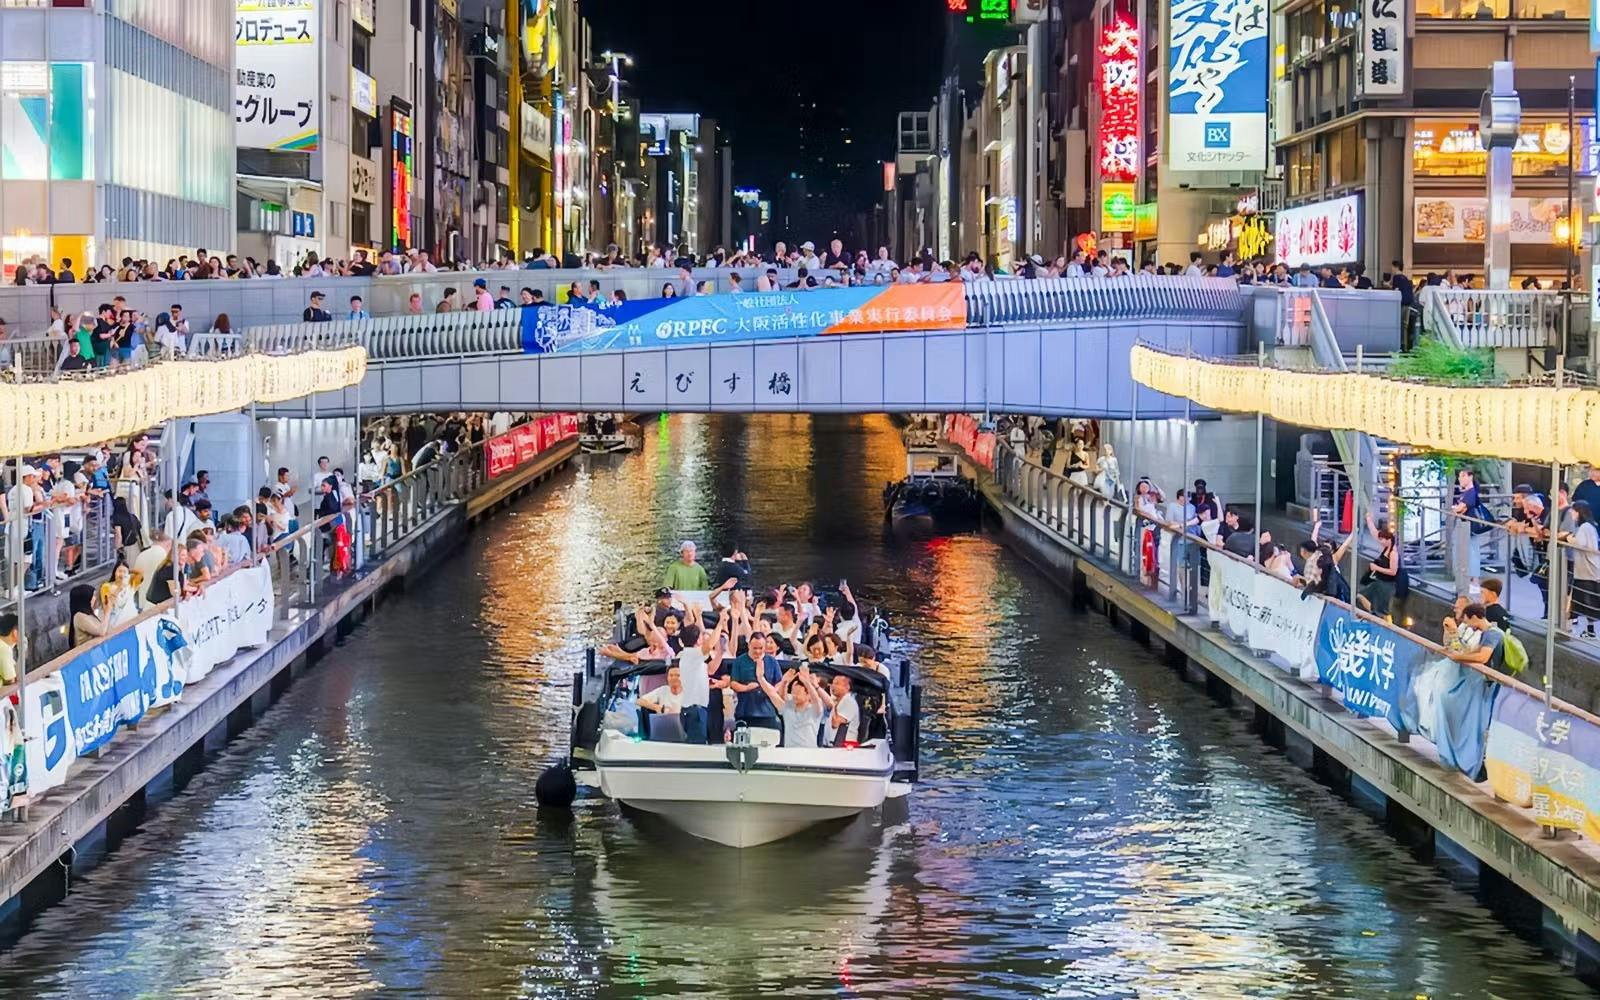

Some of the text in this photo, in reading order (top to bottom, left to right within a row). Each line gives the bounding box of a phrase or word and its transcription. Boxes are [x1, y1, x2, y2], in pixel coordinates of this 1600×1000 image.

[1208, 127, 1228, 142] BX
[630, 371, 792, 396] えびす橋
